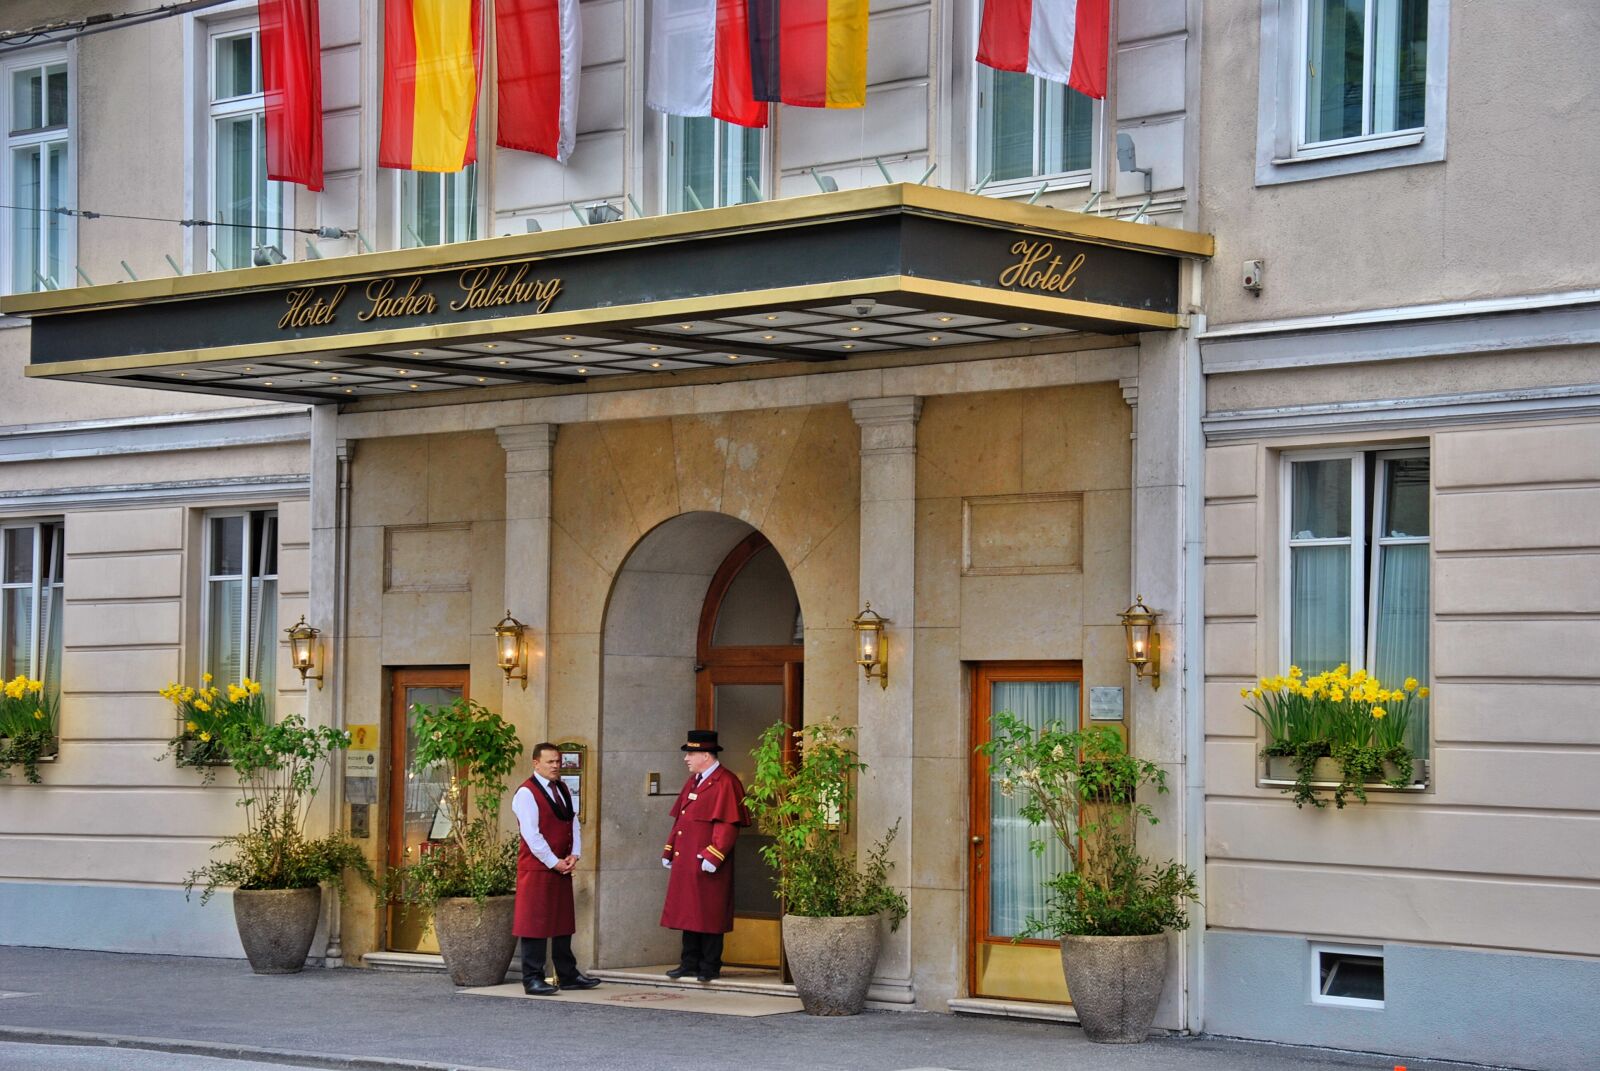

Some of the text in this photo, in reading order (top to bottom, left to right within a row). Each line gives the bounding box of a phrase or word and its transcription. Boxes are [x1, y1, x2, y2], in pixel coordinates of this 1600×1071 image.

[278, 263, 563, 329] Hotel Sacher Salzburg
[999, 239, 1086, 293] Hotel
